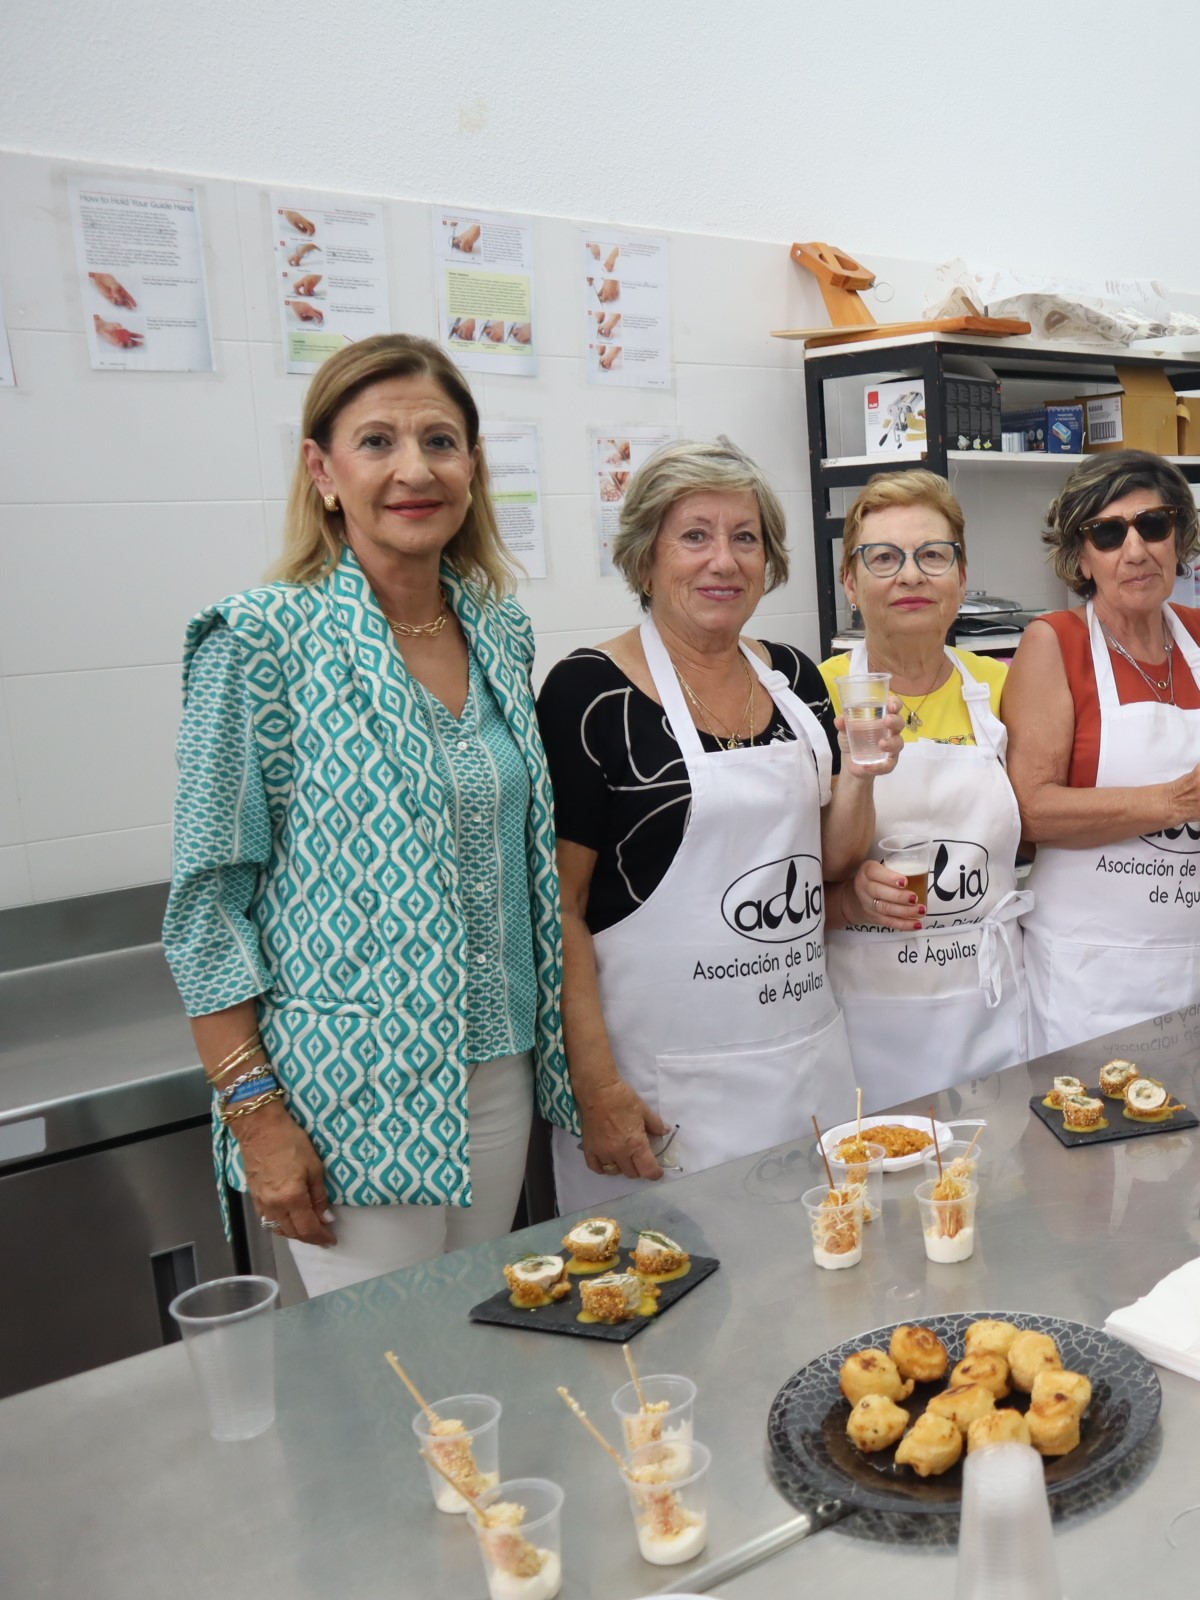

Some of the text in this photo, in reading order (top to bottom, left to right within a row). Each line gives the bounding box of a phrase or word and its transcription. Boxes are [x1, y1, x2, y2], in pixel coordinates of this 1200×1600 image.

[1095, 854, 1174, 877] Asociación
[1179, 859, 1197, 877] de
[1149, 885, 1169, 904] de
[693, 953, 780, 980] Asociación
[785, 947, 802, 968] de
[898, 939, 977, 966] de Águilas
[759, 971, 823, 1005] de Águilas
